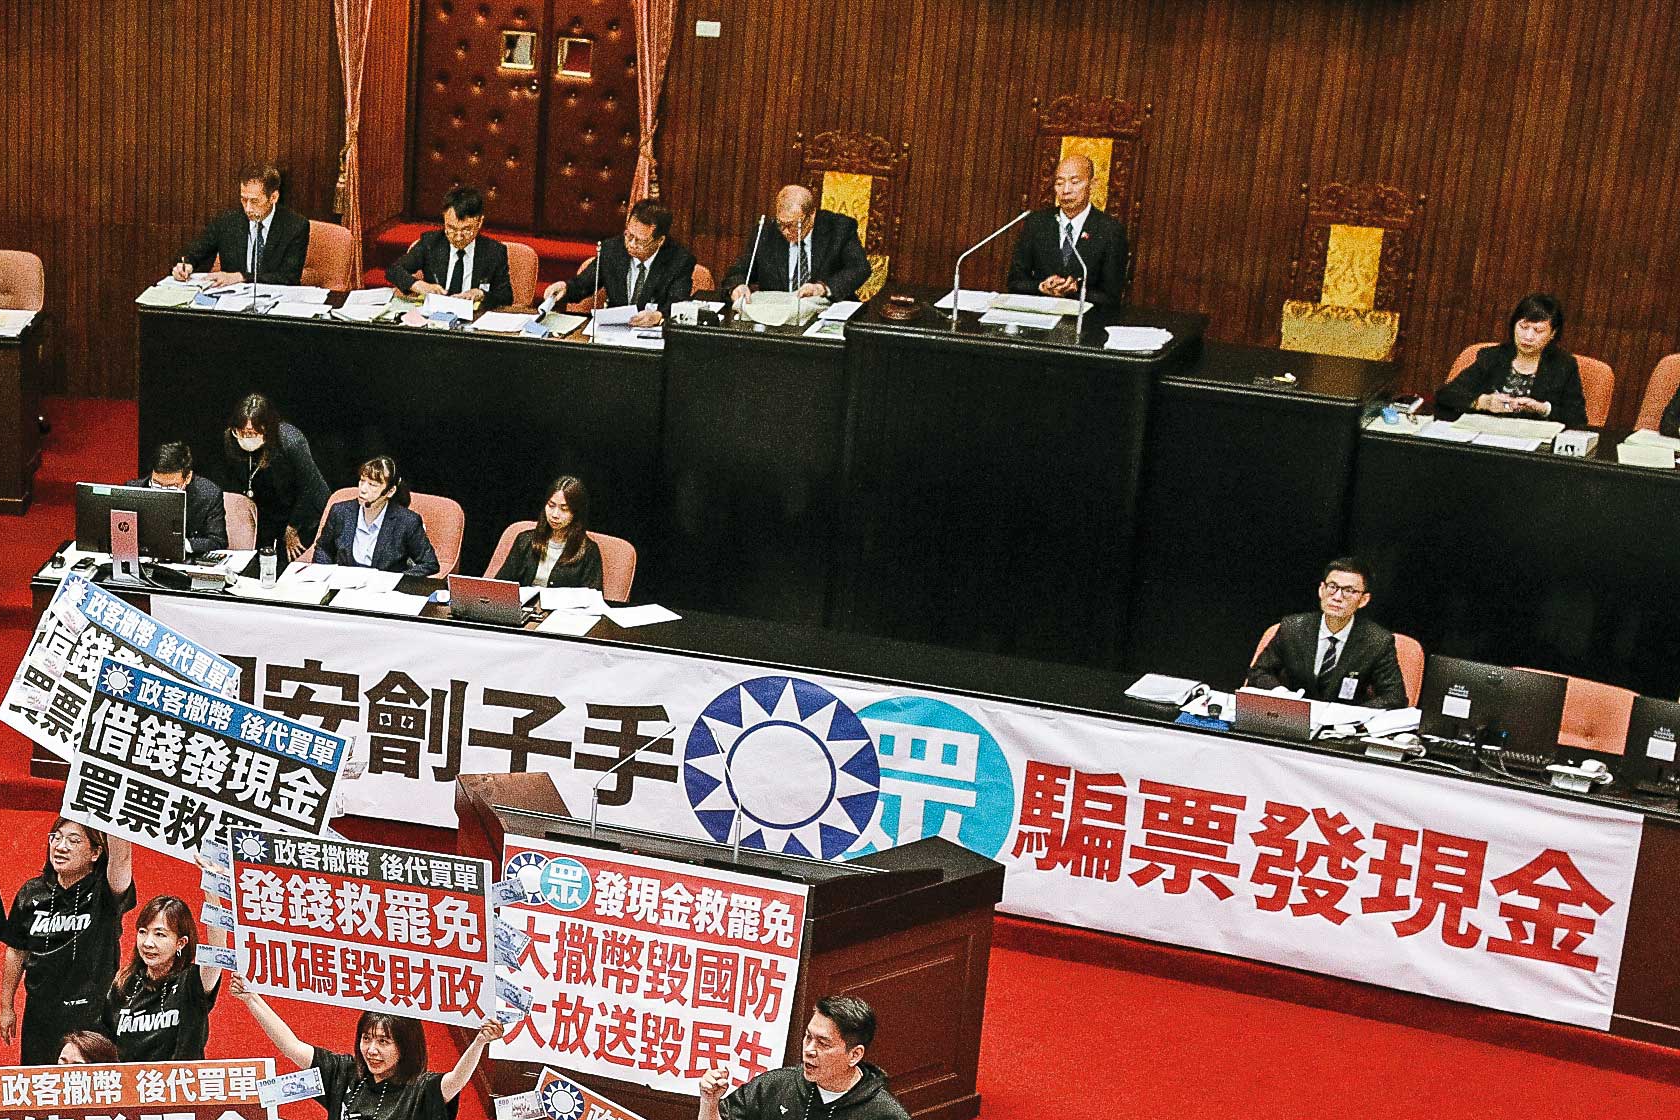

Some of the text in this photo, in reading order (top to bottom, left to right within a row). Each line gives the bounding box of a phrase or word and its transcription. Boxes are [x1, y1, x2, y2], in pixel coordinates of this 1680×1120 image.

[84, 590, 228, 692] 政客撒幣 後代買單
[88, 698, 326, 825] 借錢發現金
[138, 677, 338, 767] 政客撒幣 後代買單
[218, 653, 681, 811] 安劊子手
[70, 761, 287, 856] 買票救
[274, 838, 478, 891] 政客撒幣 後代買單
[594, 870, 796, 949] 發現金救罷免
[1011, 759, 1614, 972] 騙票發現金
[238, 869, 480, 953] 發錢救罷免
[244, 931, 486, 1020] 加碼毀財政
[508, 916, 787, 1023] 大撒幣毀國防
[1, 1066, 258, 1107] 政客撒幣 後代買單
